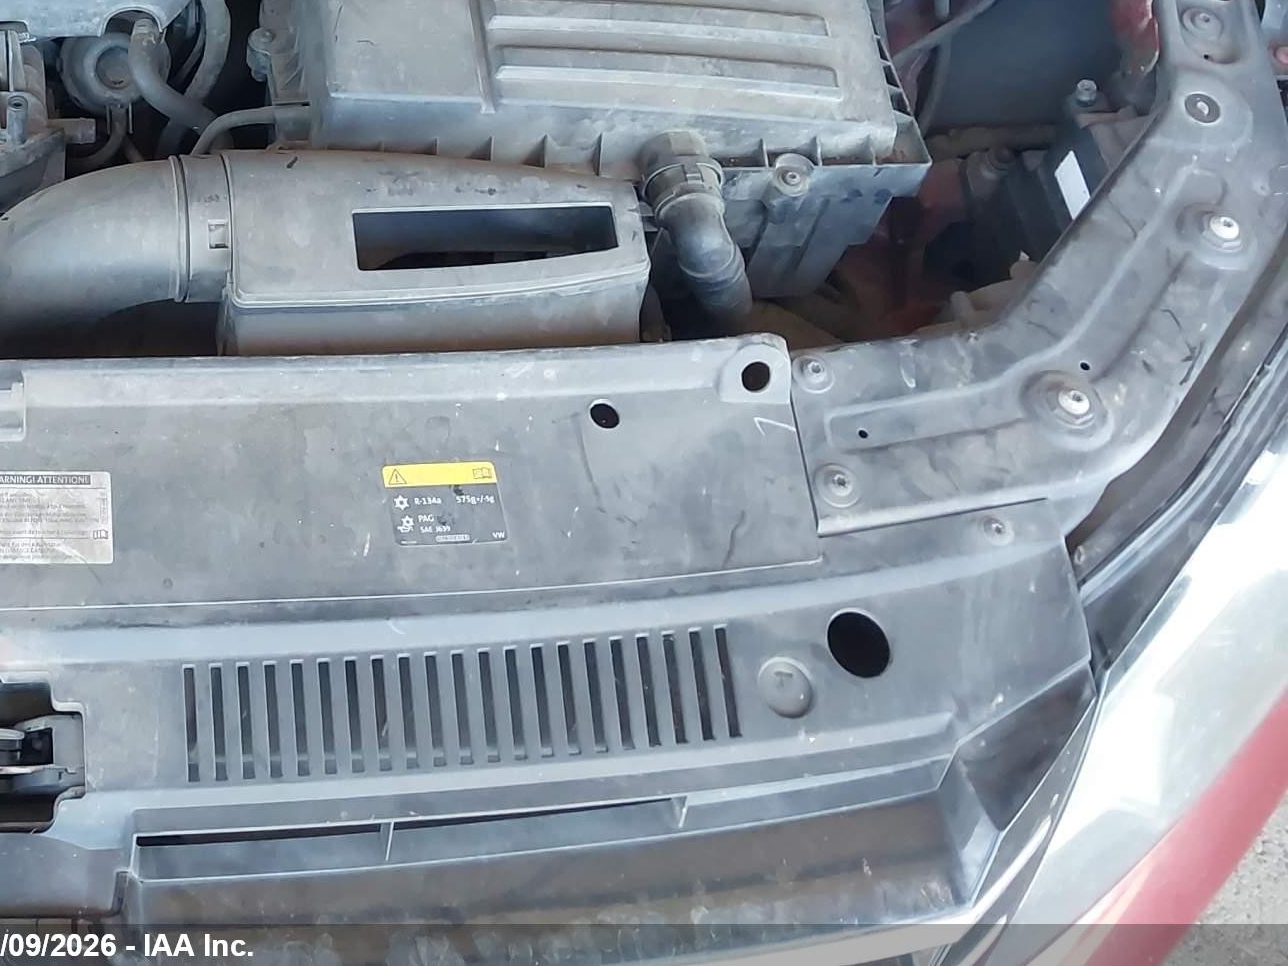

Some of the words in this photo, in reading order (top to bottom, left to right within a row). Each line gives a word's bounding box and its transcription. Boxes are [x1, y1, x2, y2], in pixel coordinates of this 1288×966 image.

[36, 475, 88, 484] ATTENTION!
[414, 496, 442, 505] R-134a
[418, 514, 434, 523] PAG
